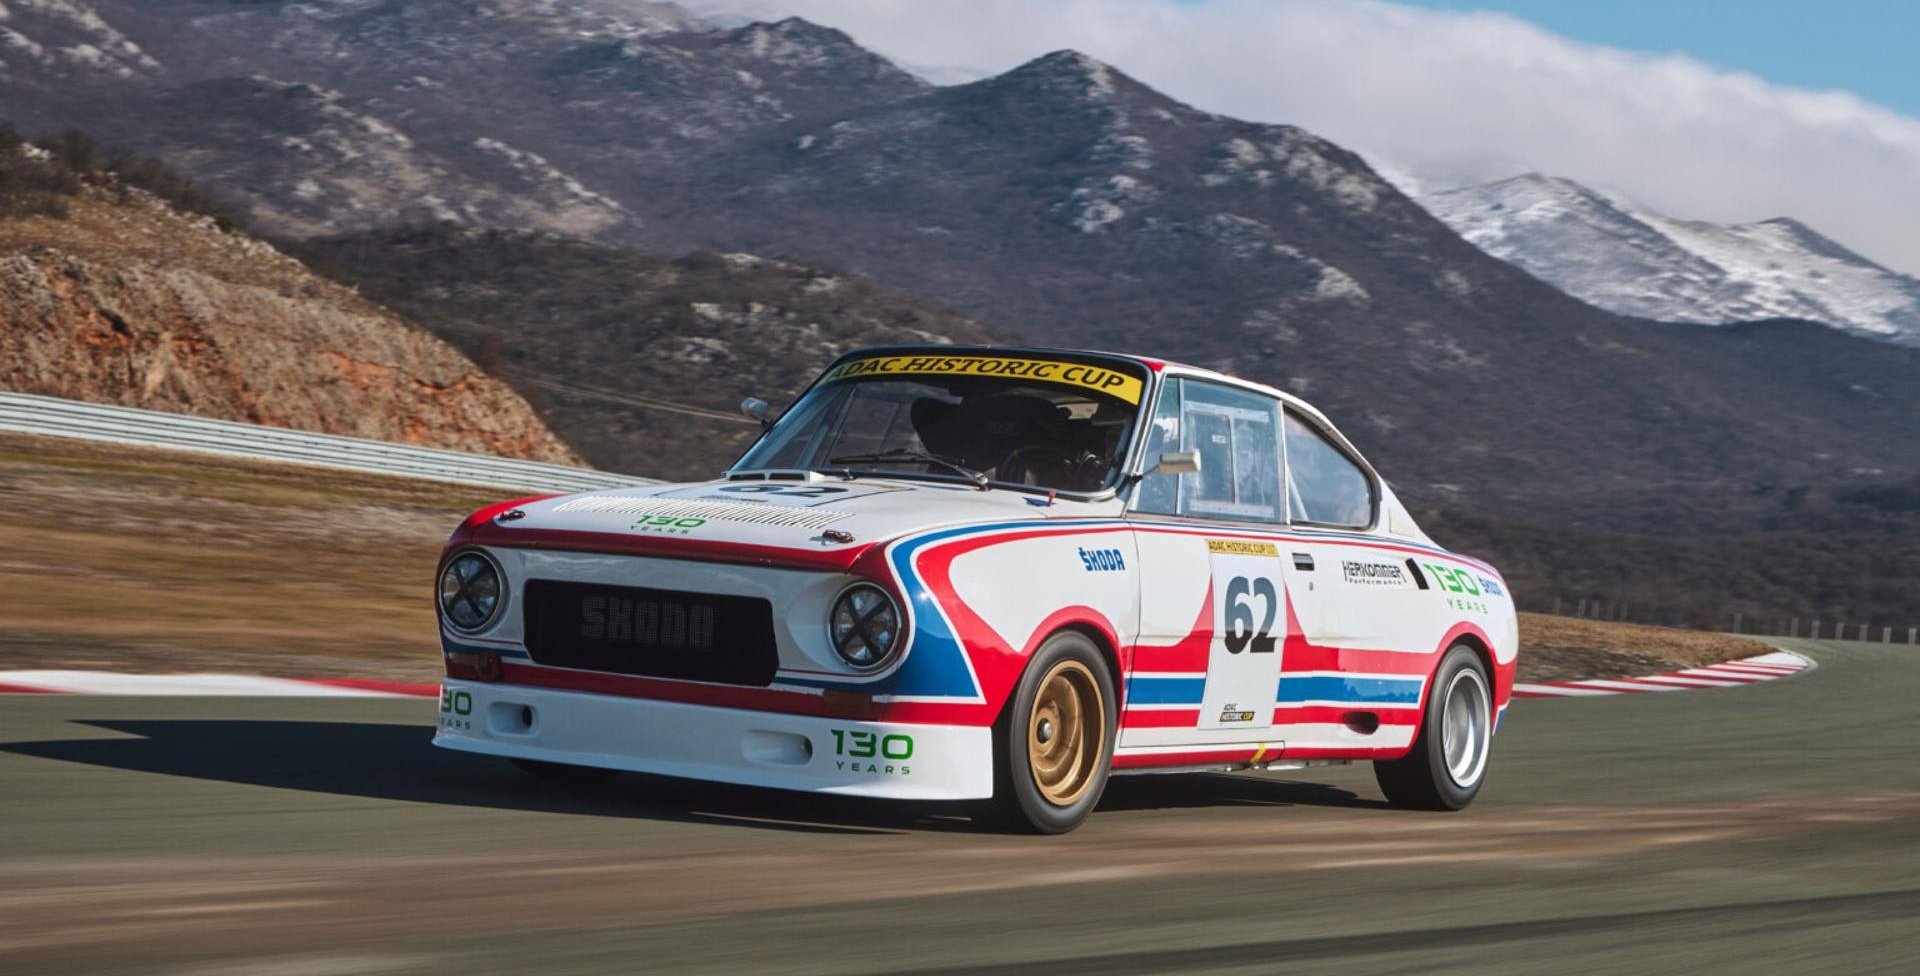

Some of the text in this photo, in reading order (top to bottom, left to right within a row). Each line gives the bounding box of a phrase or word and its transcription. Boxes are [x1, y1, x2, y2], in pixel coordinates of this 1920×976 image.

[830, 357, 1125, 390] ADAC HISTORIC CUP
[719, 484, 850, 498] 62
[637, 515, 706, 528] 130
[630, 525, 690, 535] YEARS
[1208, 541, 1226, 552] ADAC
[1078, 547, 1126, 571] ŠKODA
[1423, 563, 1480, 597] 130
[1446, 598, 1489, 614] YEARS
[1224, 576, 1277, 655] 62
[441, 689, 472, 716] 30
[441, 717, 471, 730] EARS
[830, 729, 914, 760] 130
[836, 761, 910, 775] YEARS
